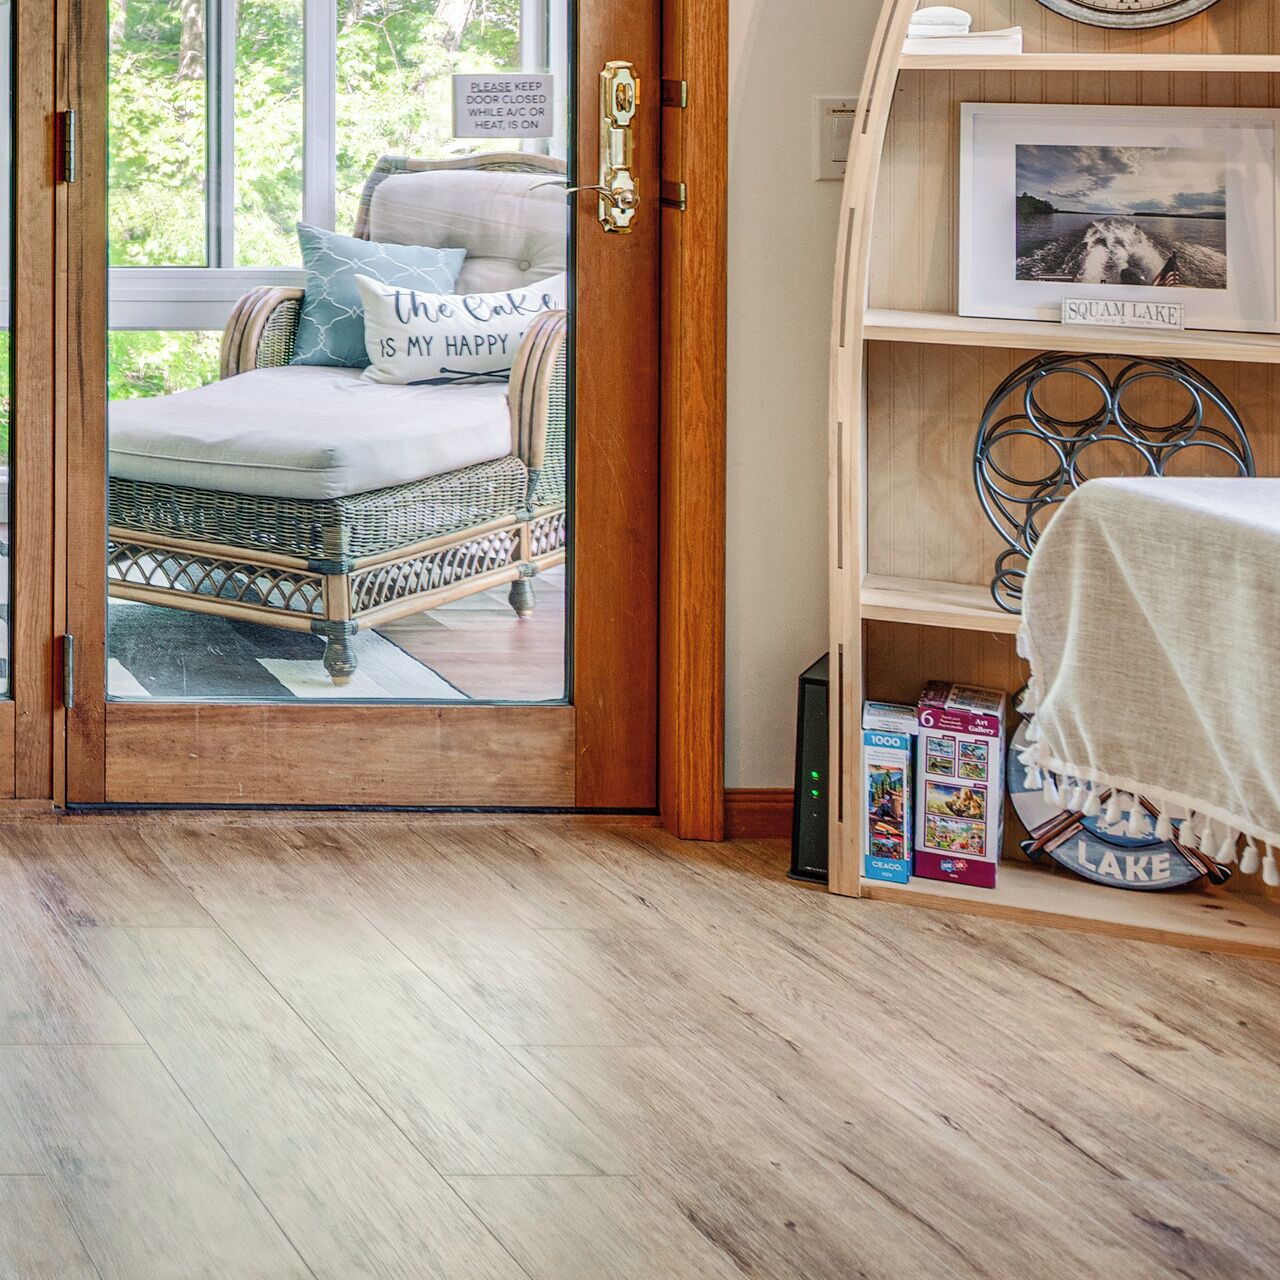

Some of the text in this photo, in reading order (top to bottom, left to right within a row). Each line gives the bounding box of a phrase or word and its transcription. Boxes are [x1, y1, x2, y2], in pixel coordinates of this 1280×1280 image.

[471, 82, 542, 92] PLEASE KEEP
[466, 95, 546, 104] DOOR CLOSED
[468, 107, 545, 116] WHILE A/C OR
[508, 121, 518, 129] IS
[521, 120, 538, 129] ON
[1068, 301, 1177, 325] SQUAM LAKE
[380, 333, 509, 357] IS MY HAPPY
[920, 710, 934, 727] 6
[976, 718, 988, 727] Art
[968, 725, 994, 735] Gallery
[871, 735, 900, 747] 1000
[1077, 840, 1171, 882] LAKE
